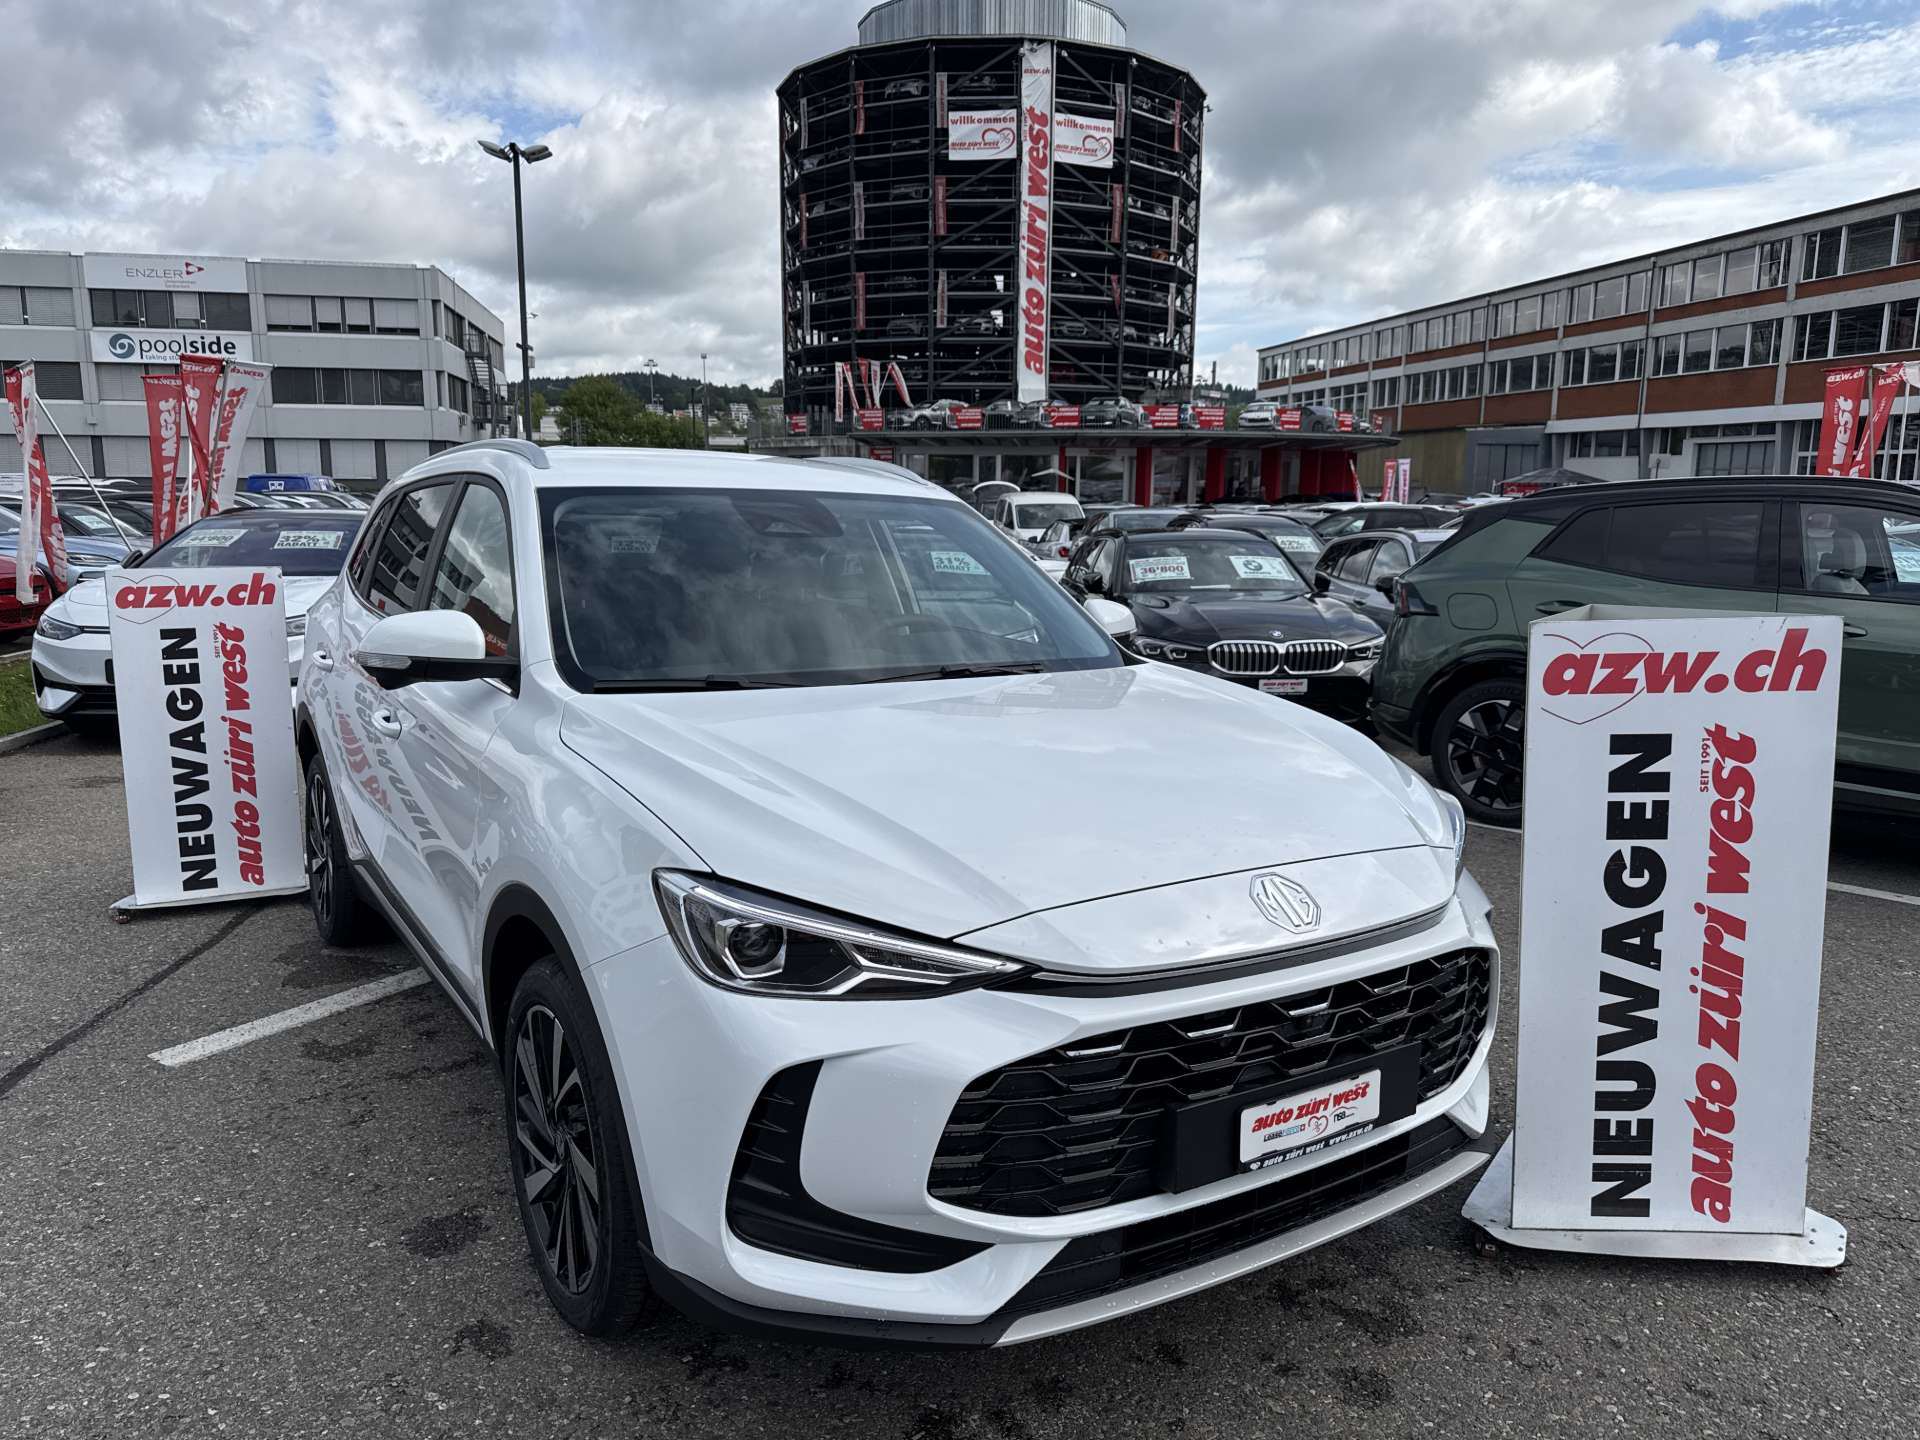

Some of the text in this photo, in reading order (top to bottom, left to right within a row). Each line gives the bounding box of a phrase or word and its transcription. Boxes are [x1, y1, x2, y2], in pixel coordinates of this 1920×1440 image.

[950, 115, 1015, 125] willkommen
[1055, 119, 1113, 133] willkommen
[1019, 105, 1050, 375] auto züri west
[126, 267, 184, 279] ENZLER
[139, 335, 237, 359] poolside
[145, 353, 168, 361] taking
[1826, 367, 1866, 383] azw.ch
[1832, 395, 1854, 465] west
[114, 572, 276, 609] azw.ch
[1541, 628, 1828, 696] azw.ch
[159, 627, 219, 892] NEUWAGEN
[212, 621, 265, 886] auto züri west
[1699, 737, 1711, 793] SEIT 1991
[1254, 877, 1317, 929] MG
[1590, 733, 1673, 1217] NEUWAGEN
[1683, 722, 1757, 1224] auto züri west
[1251, 1107, 1294, 1133] auto
[1294, 1092, 1332, 1120] züri
[1332, 1082, 1370, 1108] west
[1262, 1154, 1284, 1168] auto
[1284, 1146, 1304, 1160] züri
[1305, 1141, 1325, 1154] west
